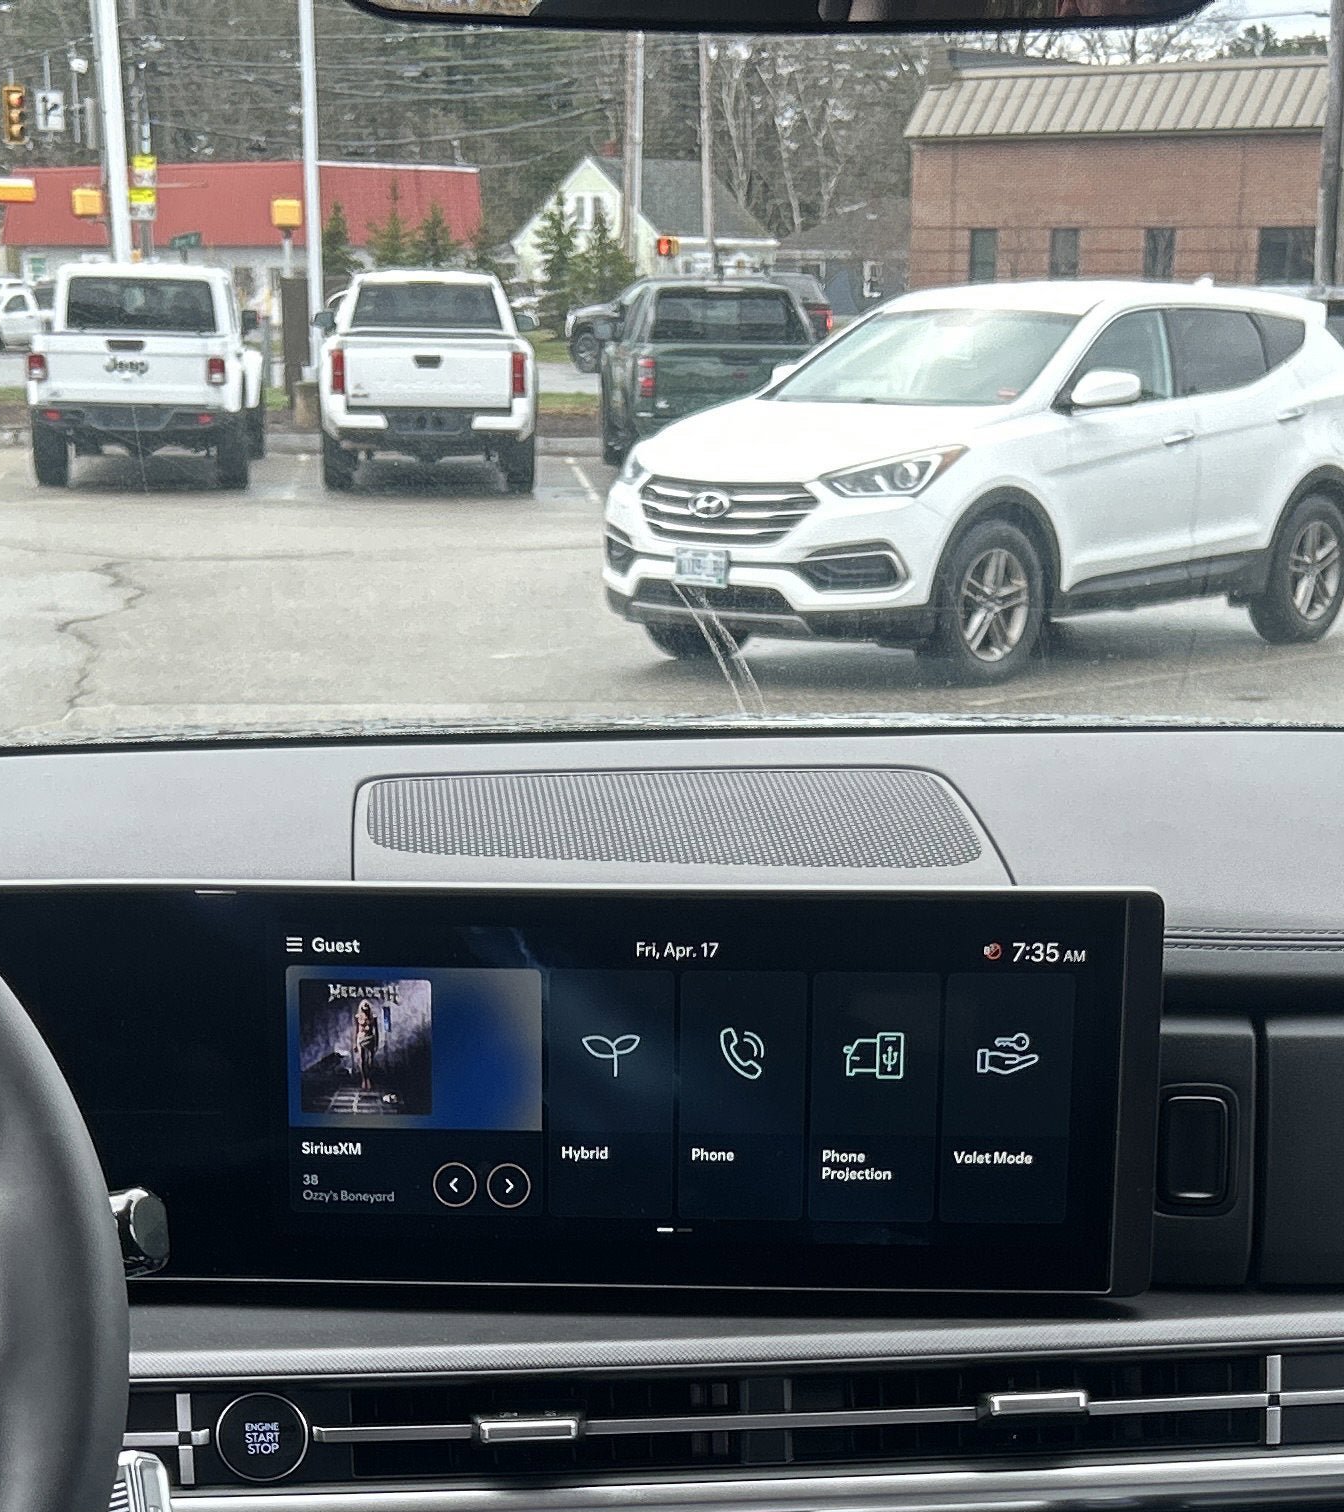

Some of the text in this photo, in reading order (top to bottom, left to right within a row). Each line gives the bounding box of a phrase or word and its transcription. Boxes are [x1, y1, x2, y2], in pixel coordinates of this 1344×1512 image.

[103, 356, 149, 375] Jeep
[311, 937, 361, 955] Guest
[636, 942, 719, 961] Fri, Apr. 17
[1012, 942, 1086, 963] 7:35 AM
[301, 1141, 362, 1156] SiriusXM
[561, 1146, 609, 1162] Hybrid
[691, 1148, 735, 1162] Phone
[822, 1150, 866, 1163] Phone
[954, 1151, 1033, 1165] Valet Mode
[303, 1174, 319, 1186] 38
[822, 1167, 892, 1182] Projection
[303, 1189, 395, 1204] Ozzy's Boneyard
[244, 1422, 279, 1432] ENGINE
[244, 1432, 280, 1443] START
[247, 1444, 280, 1455] STOP
